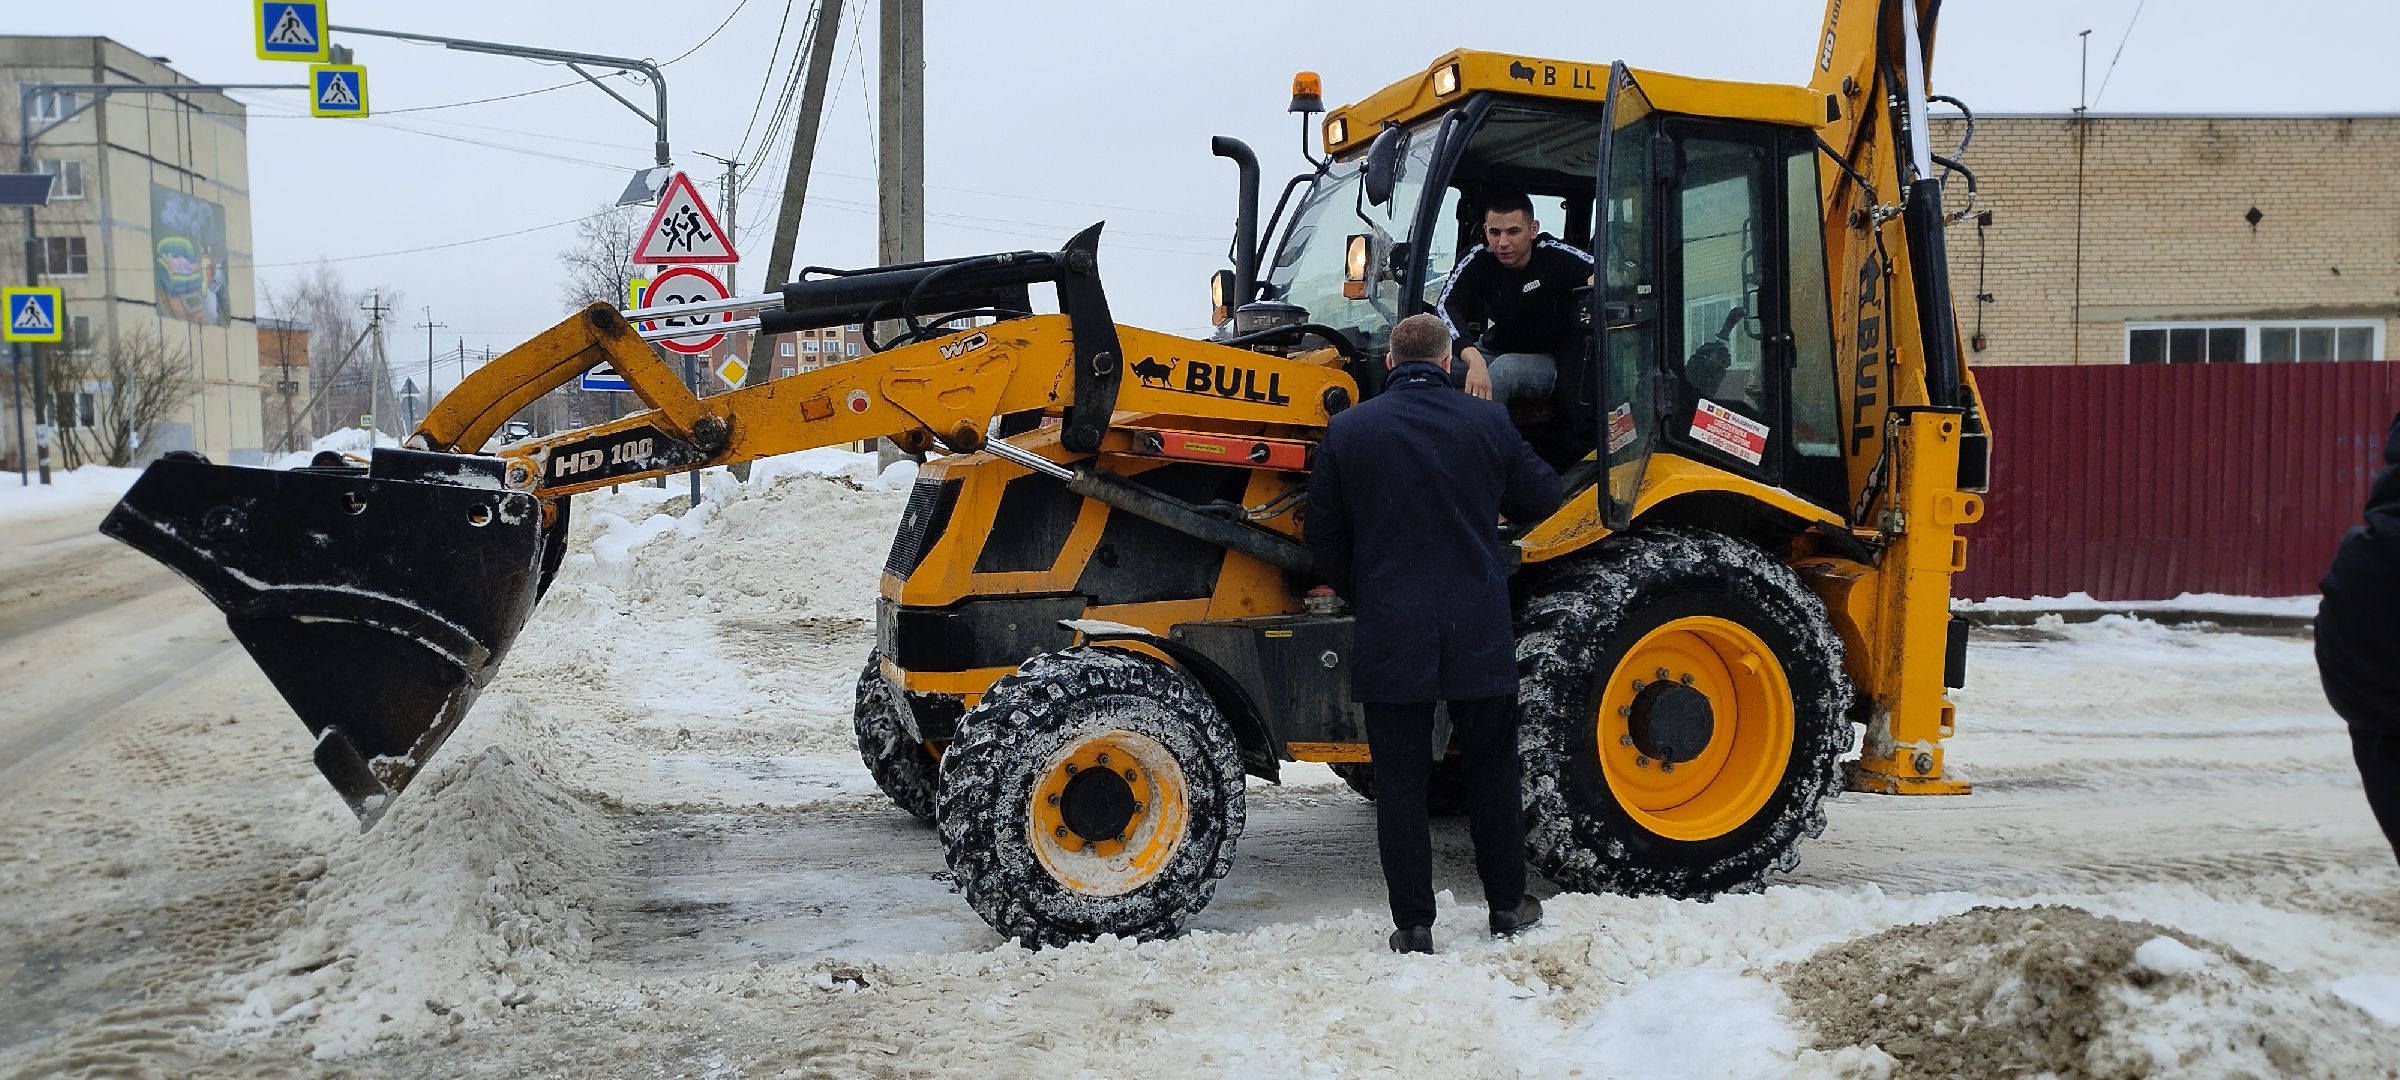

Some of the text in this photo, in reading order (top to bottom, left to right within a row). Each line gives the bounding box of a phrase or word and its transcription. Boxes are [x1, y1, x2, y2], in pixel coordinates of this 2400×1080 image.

[1185, 360, 1290, 404] BULL
[1852, 316, 1880, 457] BULL
[556, 438, 653, 477] HD 100
